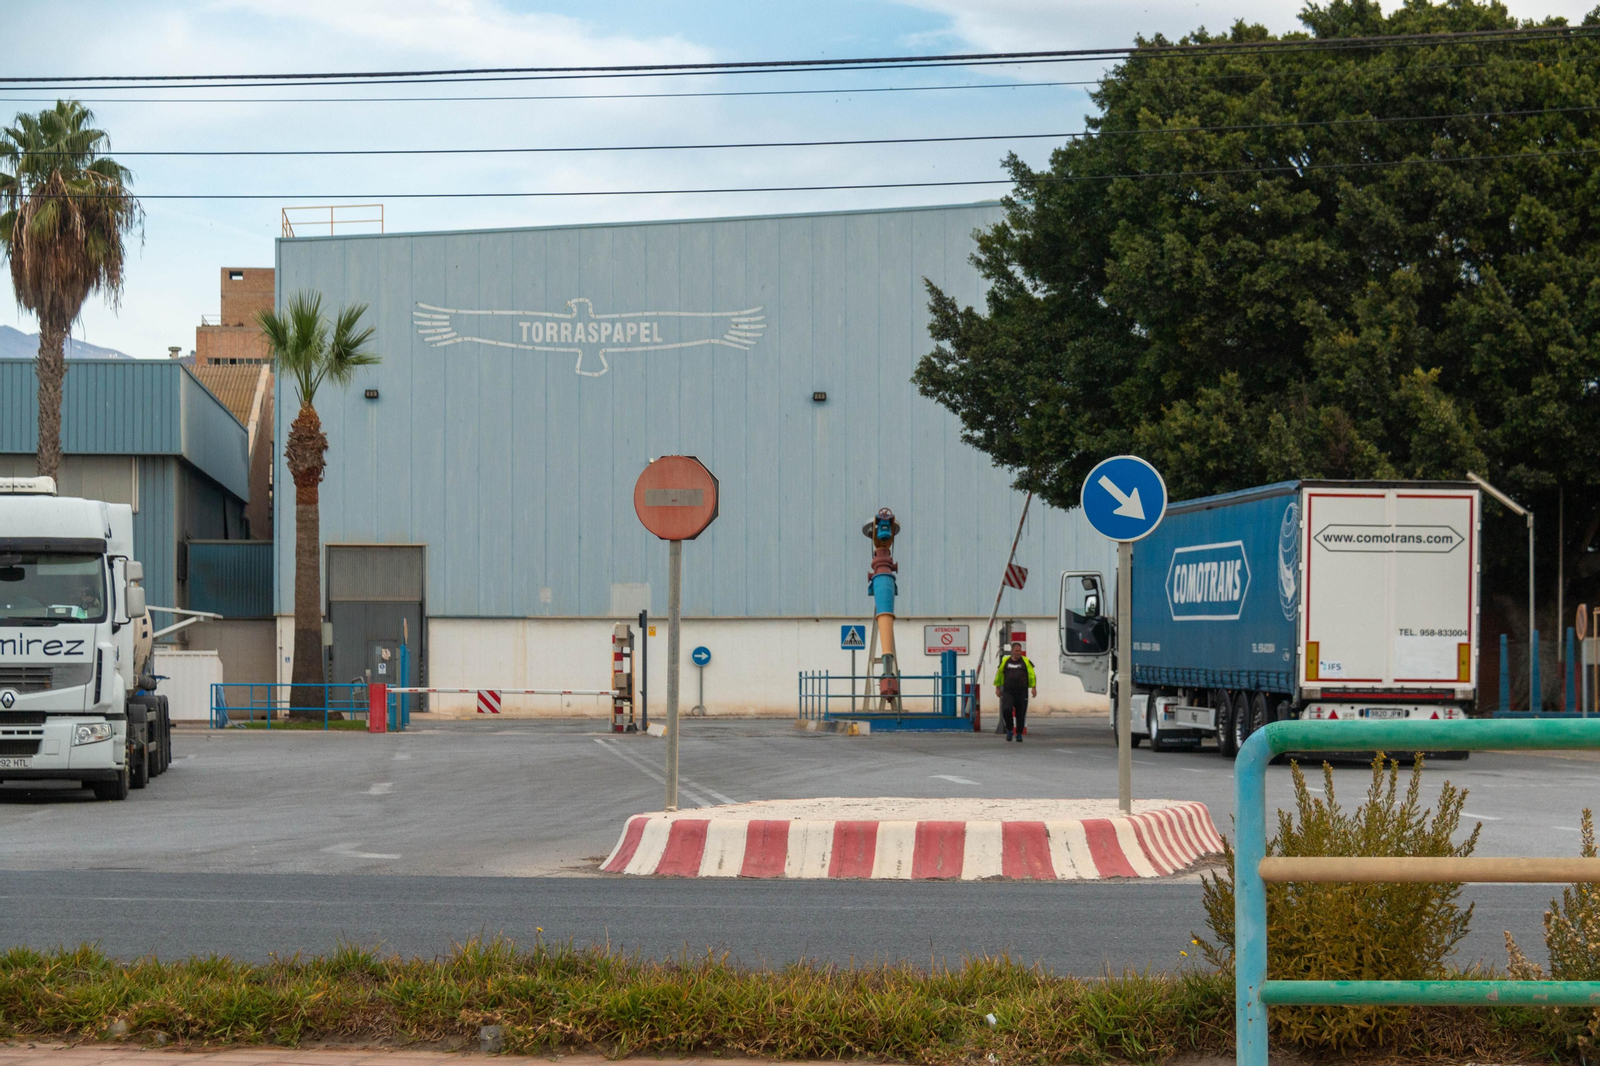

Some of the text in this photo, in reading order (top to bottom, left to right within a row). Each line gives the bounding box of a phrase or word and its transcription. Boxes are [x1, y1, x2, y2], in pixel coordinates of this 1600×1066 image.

[518, 321, 663, 343] TORRASPAPEL
[1322, 533, 1453, 544] www.comotrans.com
[1173, 559, 1242, 604] COMOTRANS
[1398, 628, 1468, 637] TEL. 958-833004
[0, 632, 85, 656] mirez
[1327, 663, 1342, 671] IFS
[1370, 710, 1387, 718] 9820
[13, 759, 29, 767] HTL
